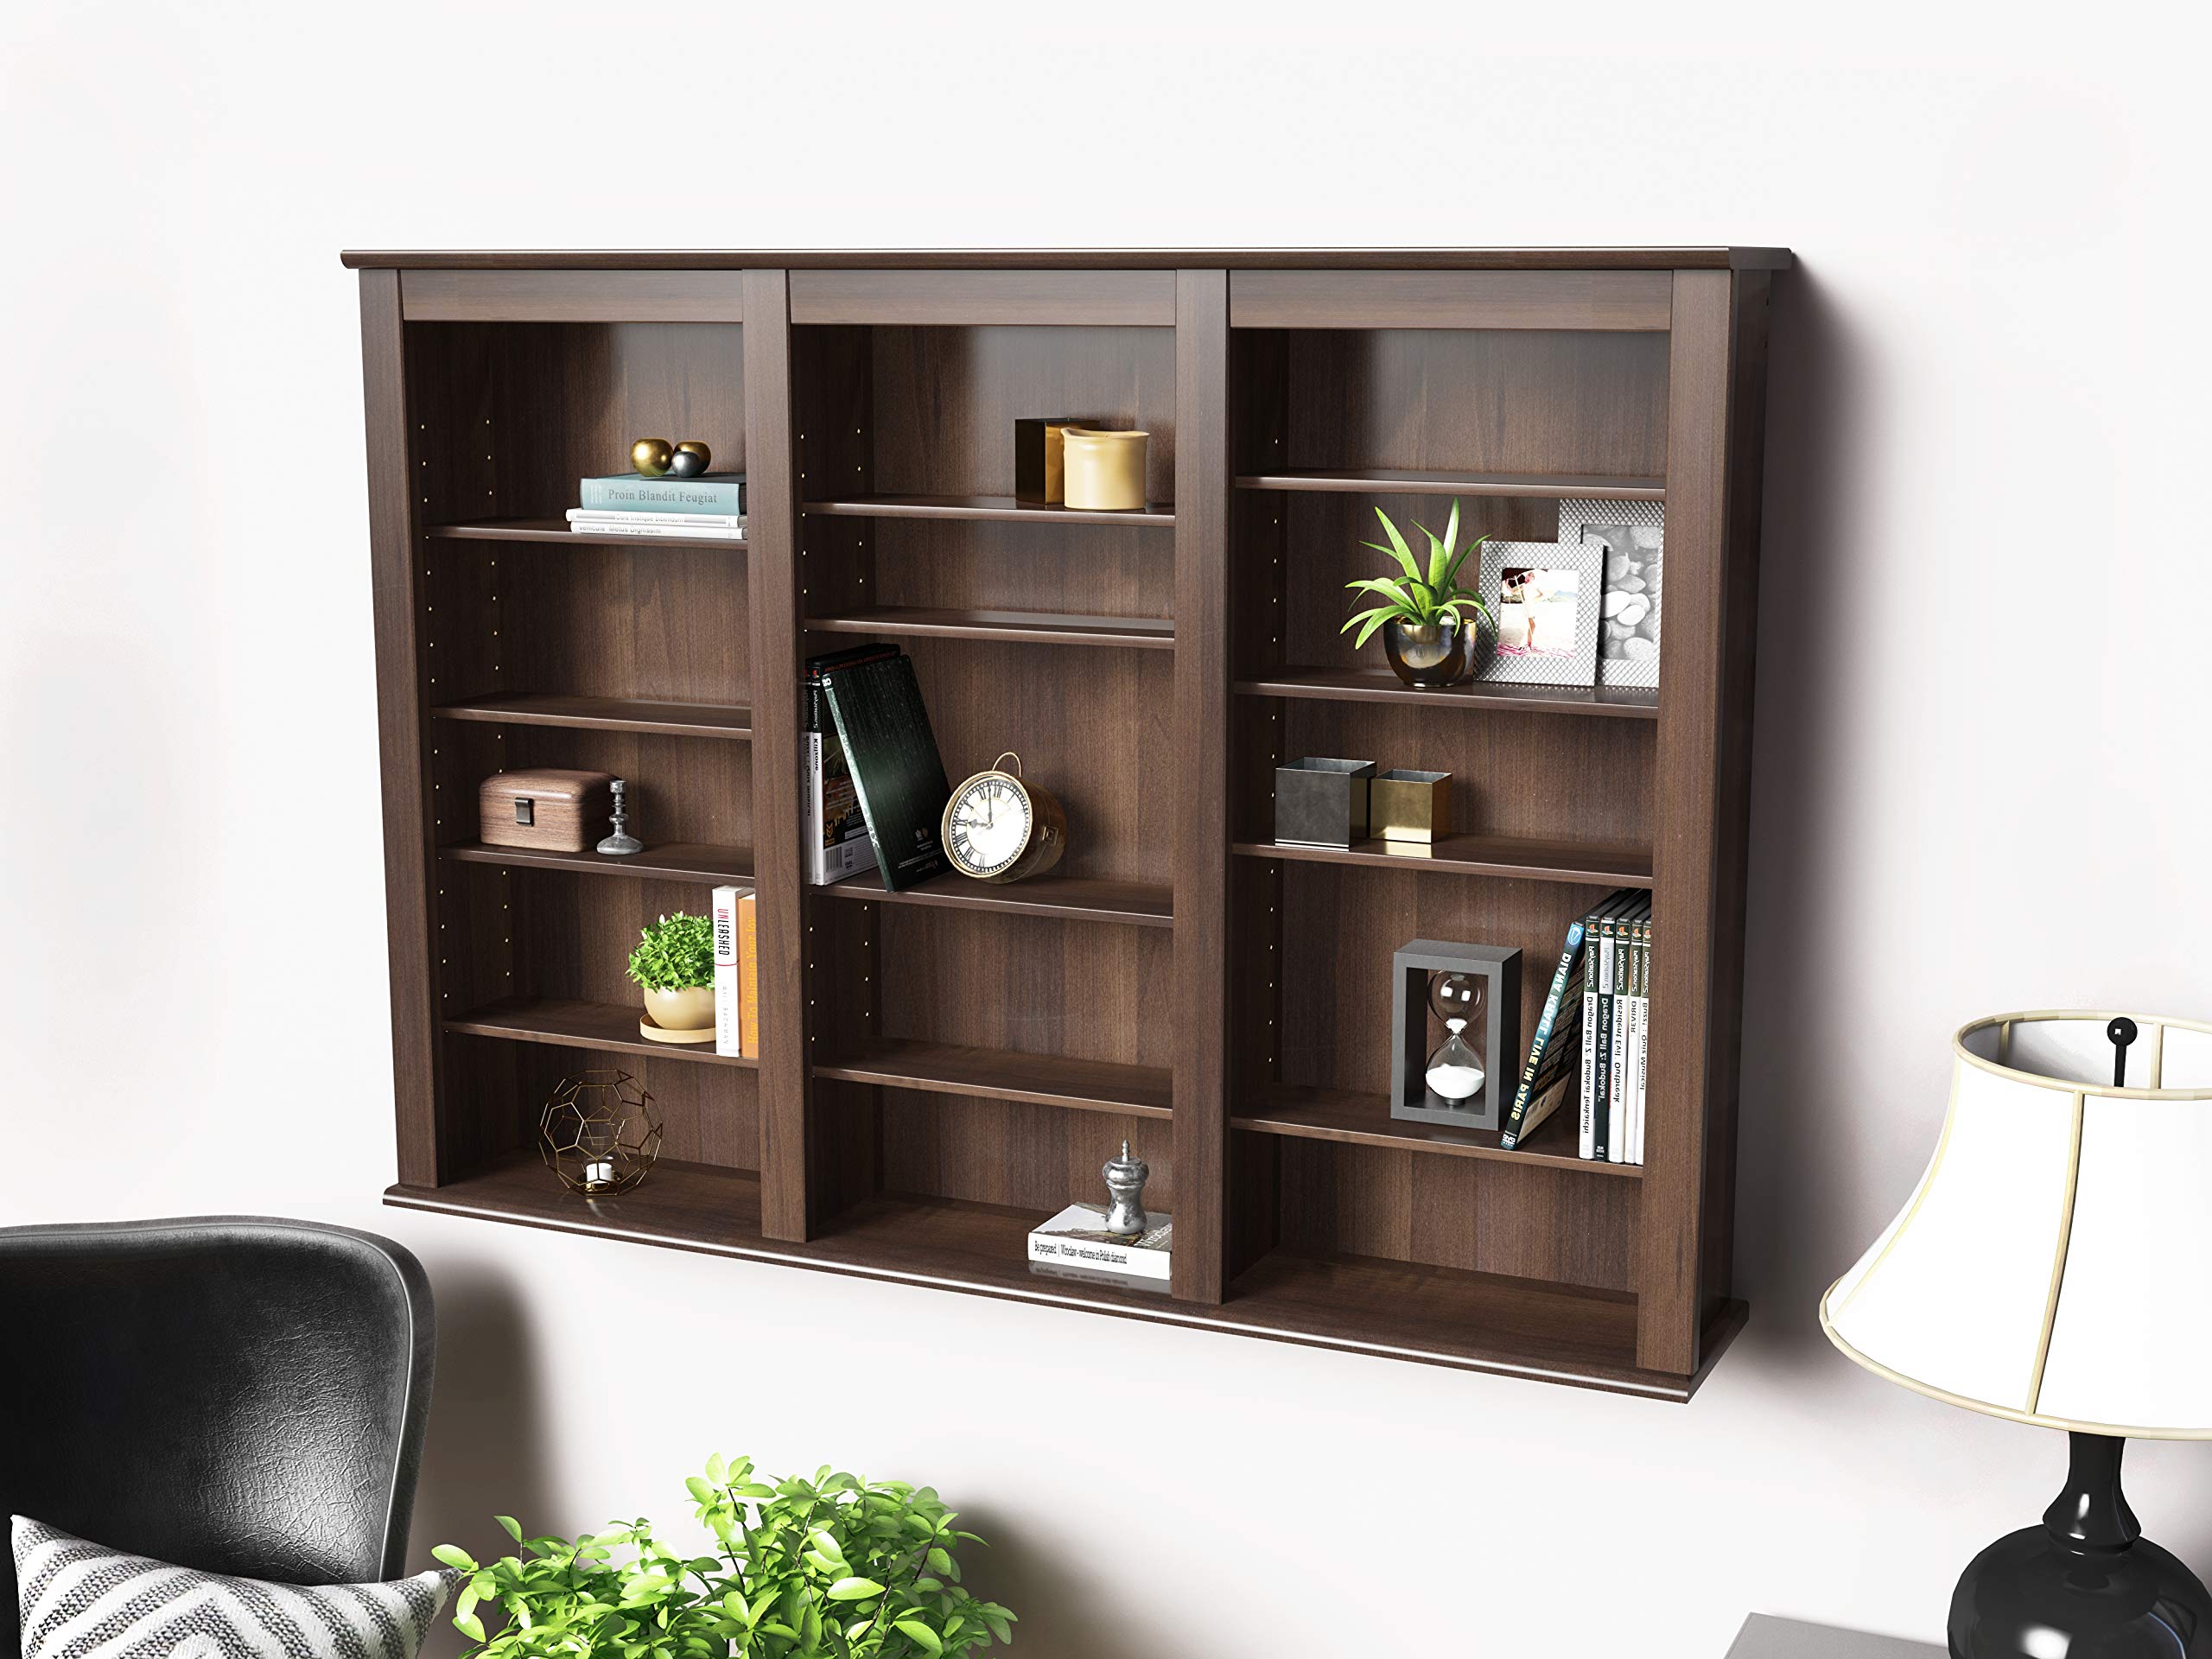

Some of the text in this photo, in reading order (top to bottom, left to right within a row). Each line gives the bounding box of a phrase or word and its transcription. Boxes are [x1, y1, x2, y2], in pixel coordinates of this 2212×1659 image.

[607, 489, 635, 500] Proin
[639, 490, 676, 501] Blandit
[679, 492, 718, 505] Feugiat
[717, 908, 730, 956] UNLEASHED
[1034, 1240, 1039, 1252] Be
[1039, 1243, 1057, 1256] prepared
[1078, 1248, 1096, 1260] welcome
